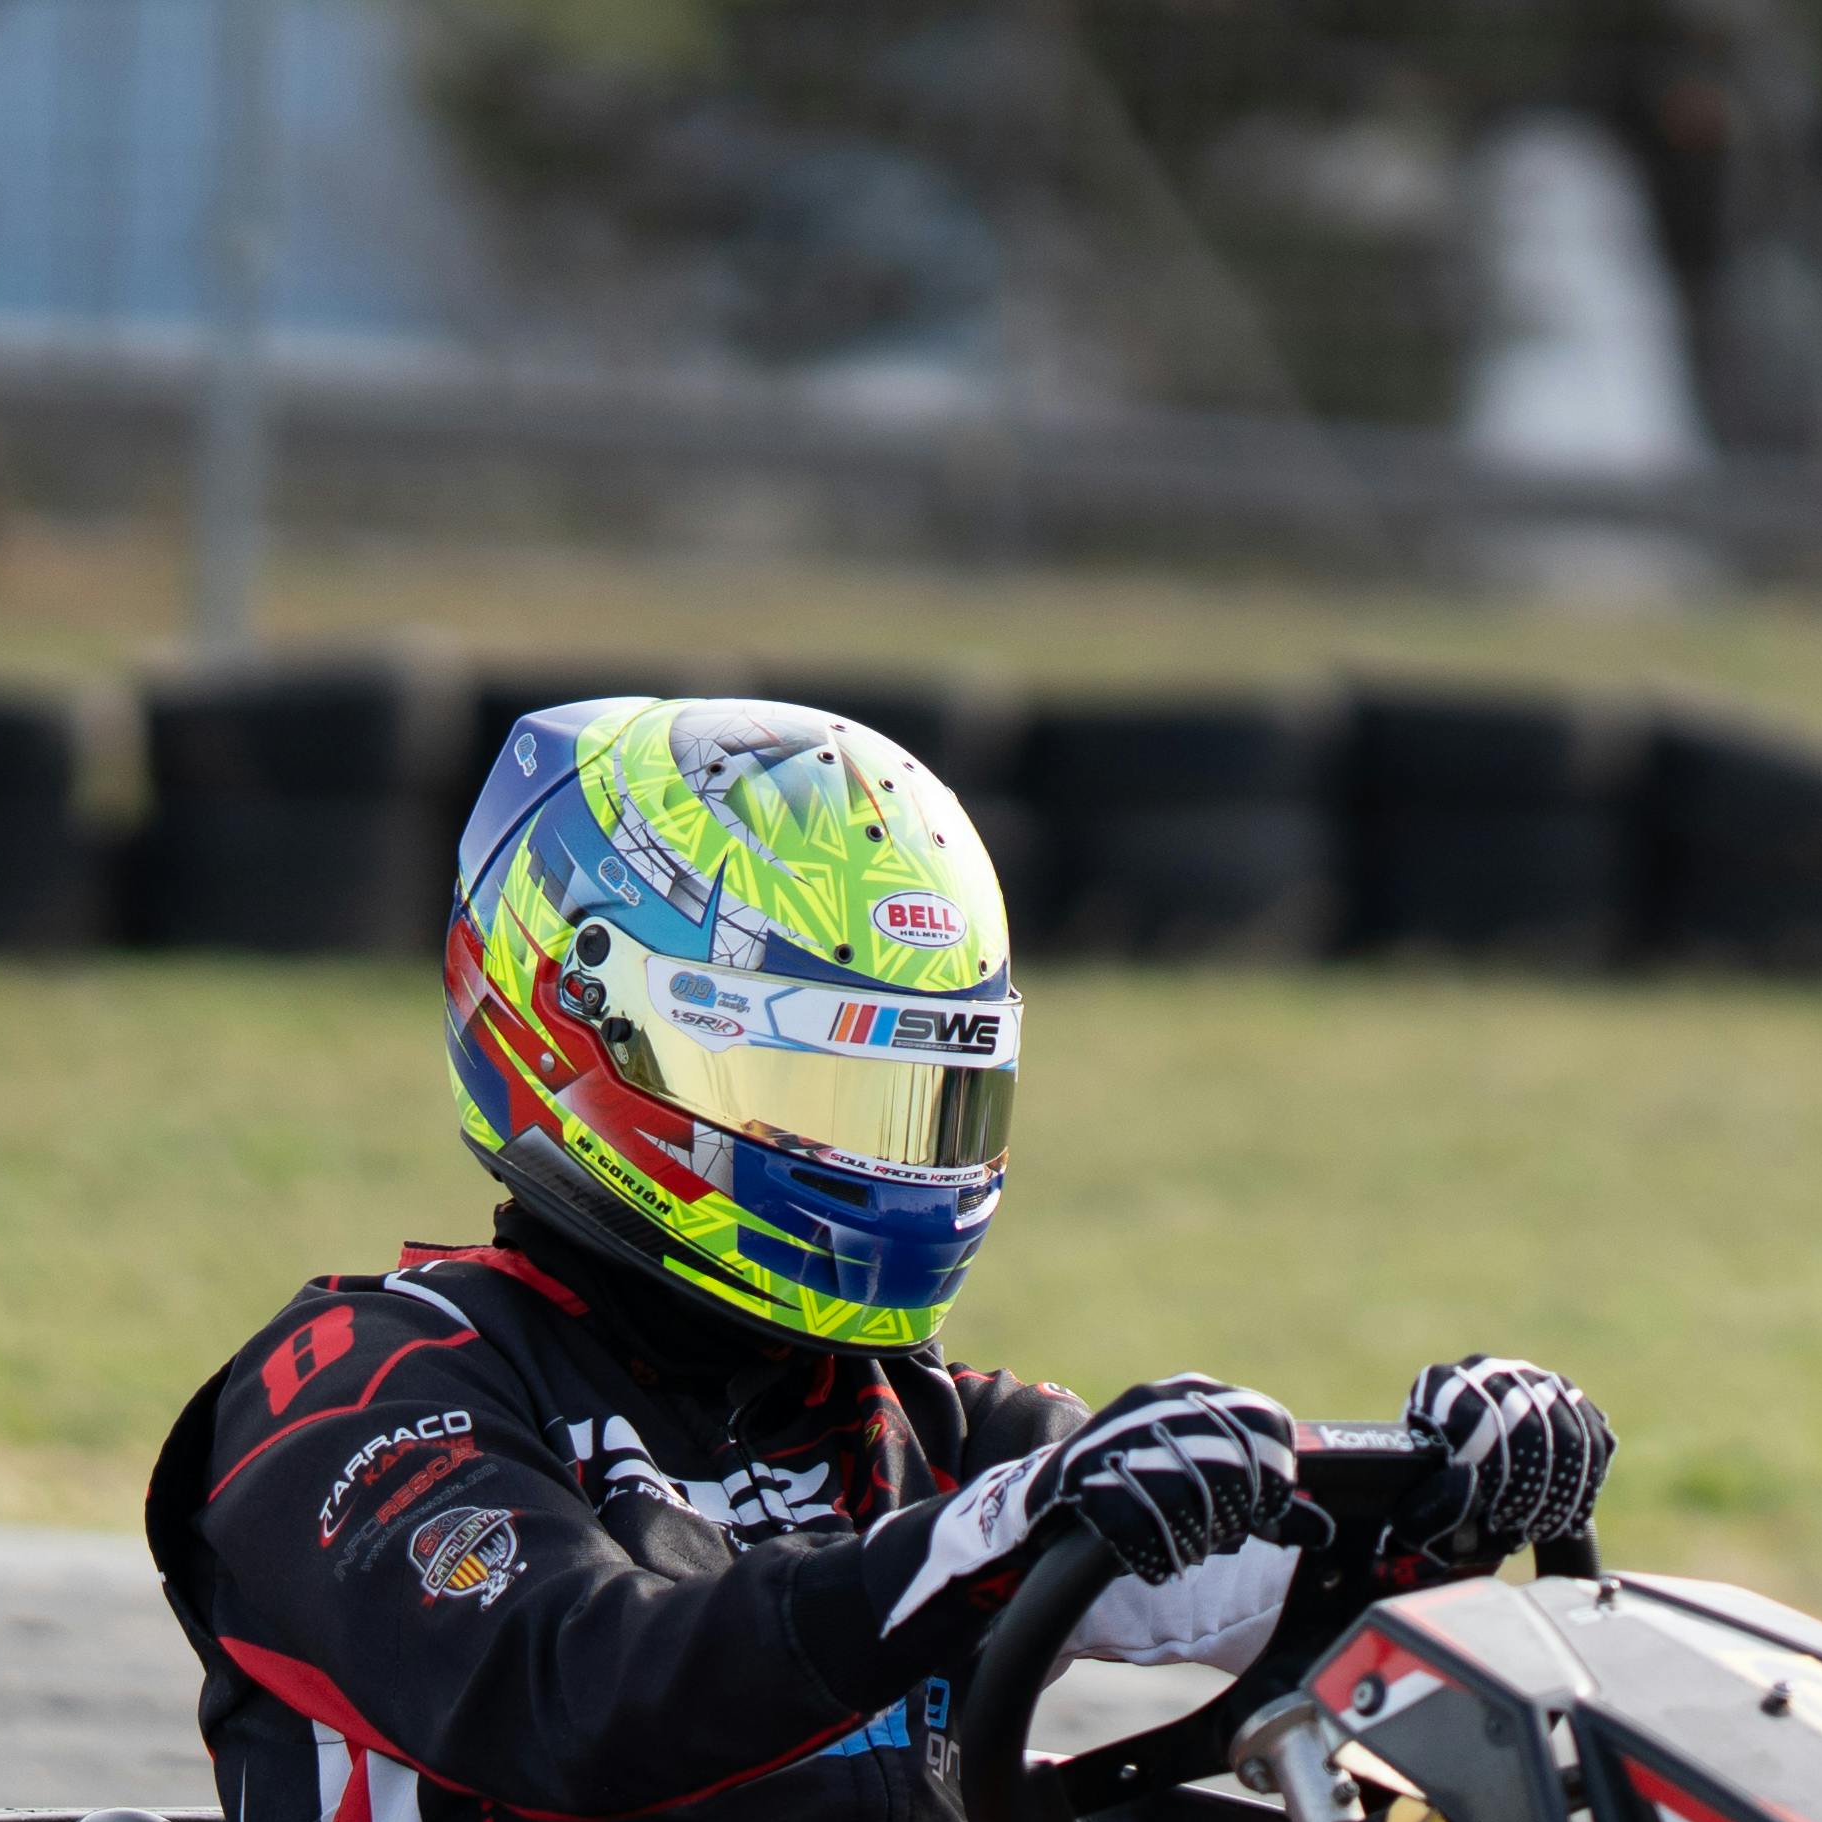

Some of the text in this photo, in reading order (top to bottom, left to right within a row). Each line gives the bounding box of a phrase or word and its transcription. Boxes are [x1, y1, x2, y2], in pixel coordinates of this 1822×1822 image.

[887, 904, 957, 932] BELL
[899, 930, 950, 940] HELMETS
[829, 1152, 870, 1171] SOUL
[874, 1164, 928, 1181] RACING
[319, 1410, 473, 1520] TARRACO
[428, 1508, 502, 1587] CATALUNYA
